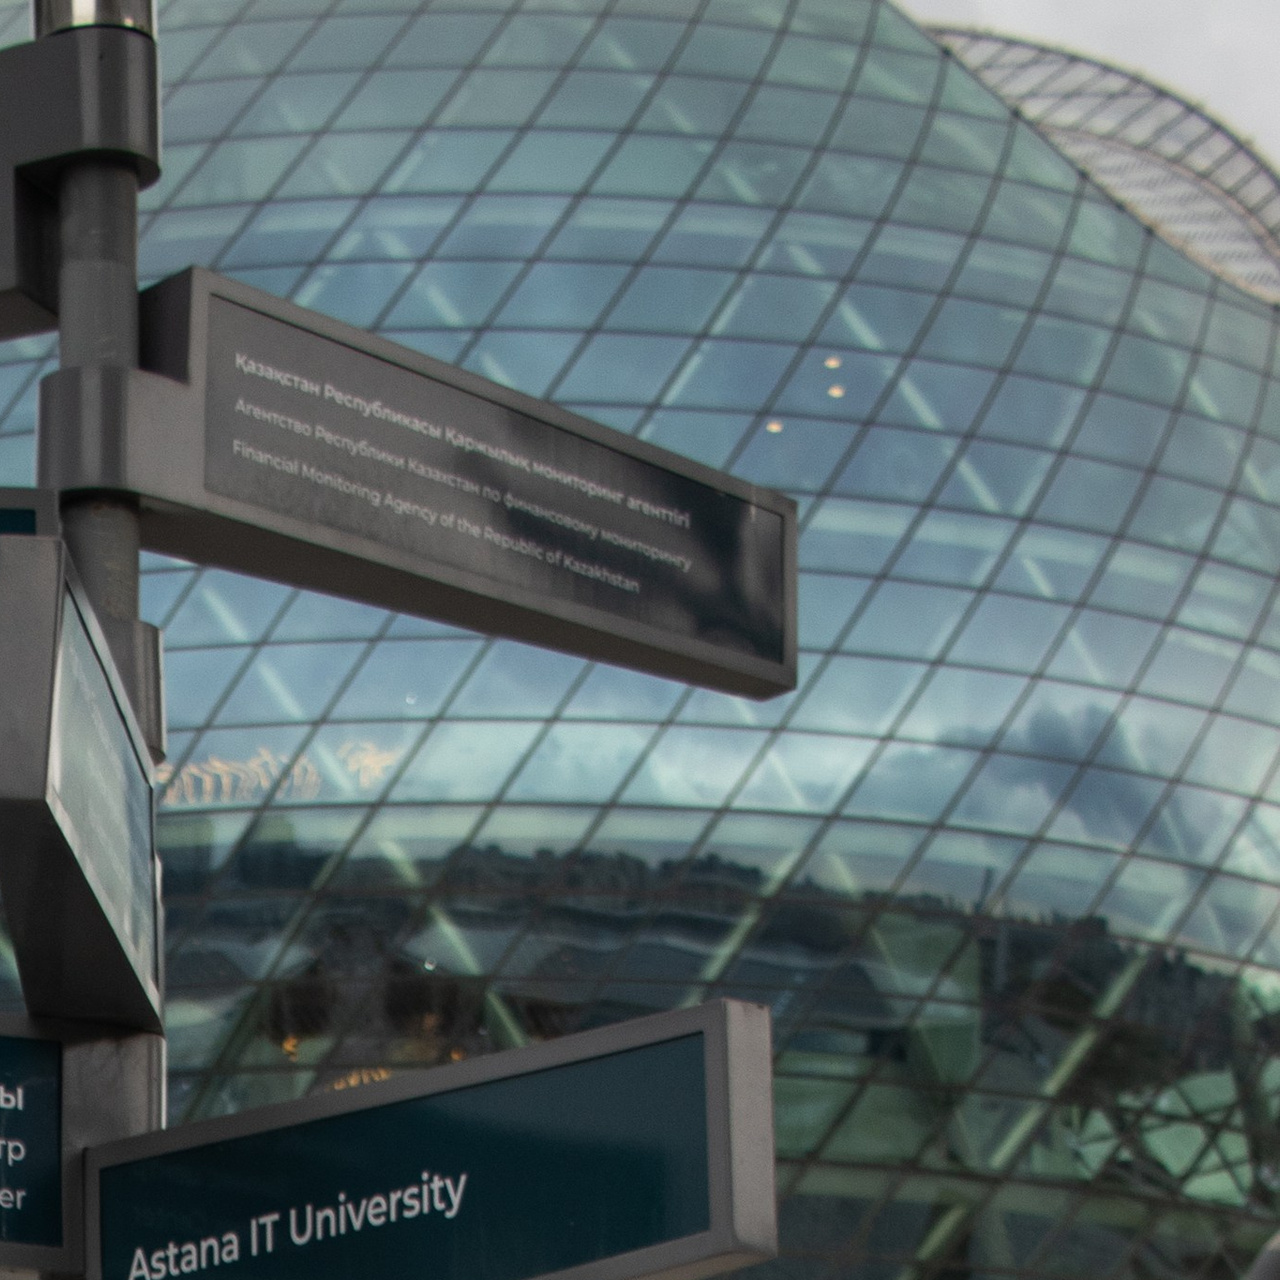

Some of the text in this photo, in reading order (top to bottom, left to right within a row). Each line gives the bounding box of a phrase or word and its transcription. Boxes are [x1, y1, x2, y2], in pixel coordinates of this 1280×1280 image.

[234, 352, 320, 396] Қазақстан
[323, 384, 442, 440] Республикасы
[232, 438, 640, 594] Financial Monitoring Agency of the Republic of Kazakhstan
[234, 398, 313, 437] Агентство
[314, 425, 405, 468] Республики
[407, 457, 480, 495] Казахстан
[482, 485, 501, 503] по
[503, 492, 599, 541] финансовому
[250, 1212, 281, 1257] IT
[289, 1169, 469, 1246] University
